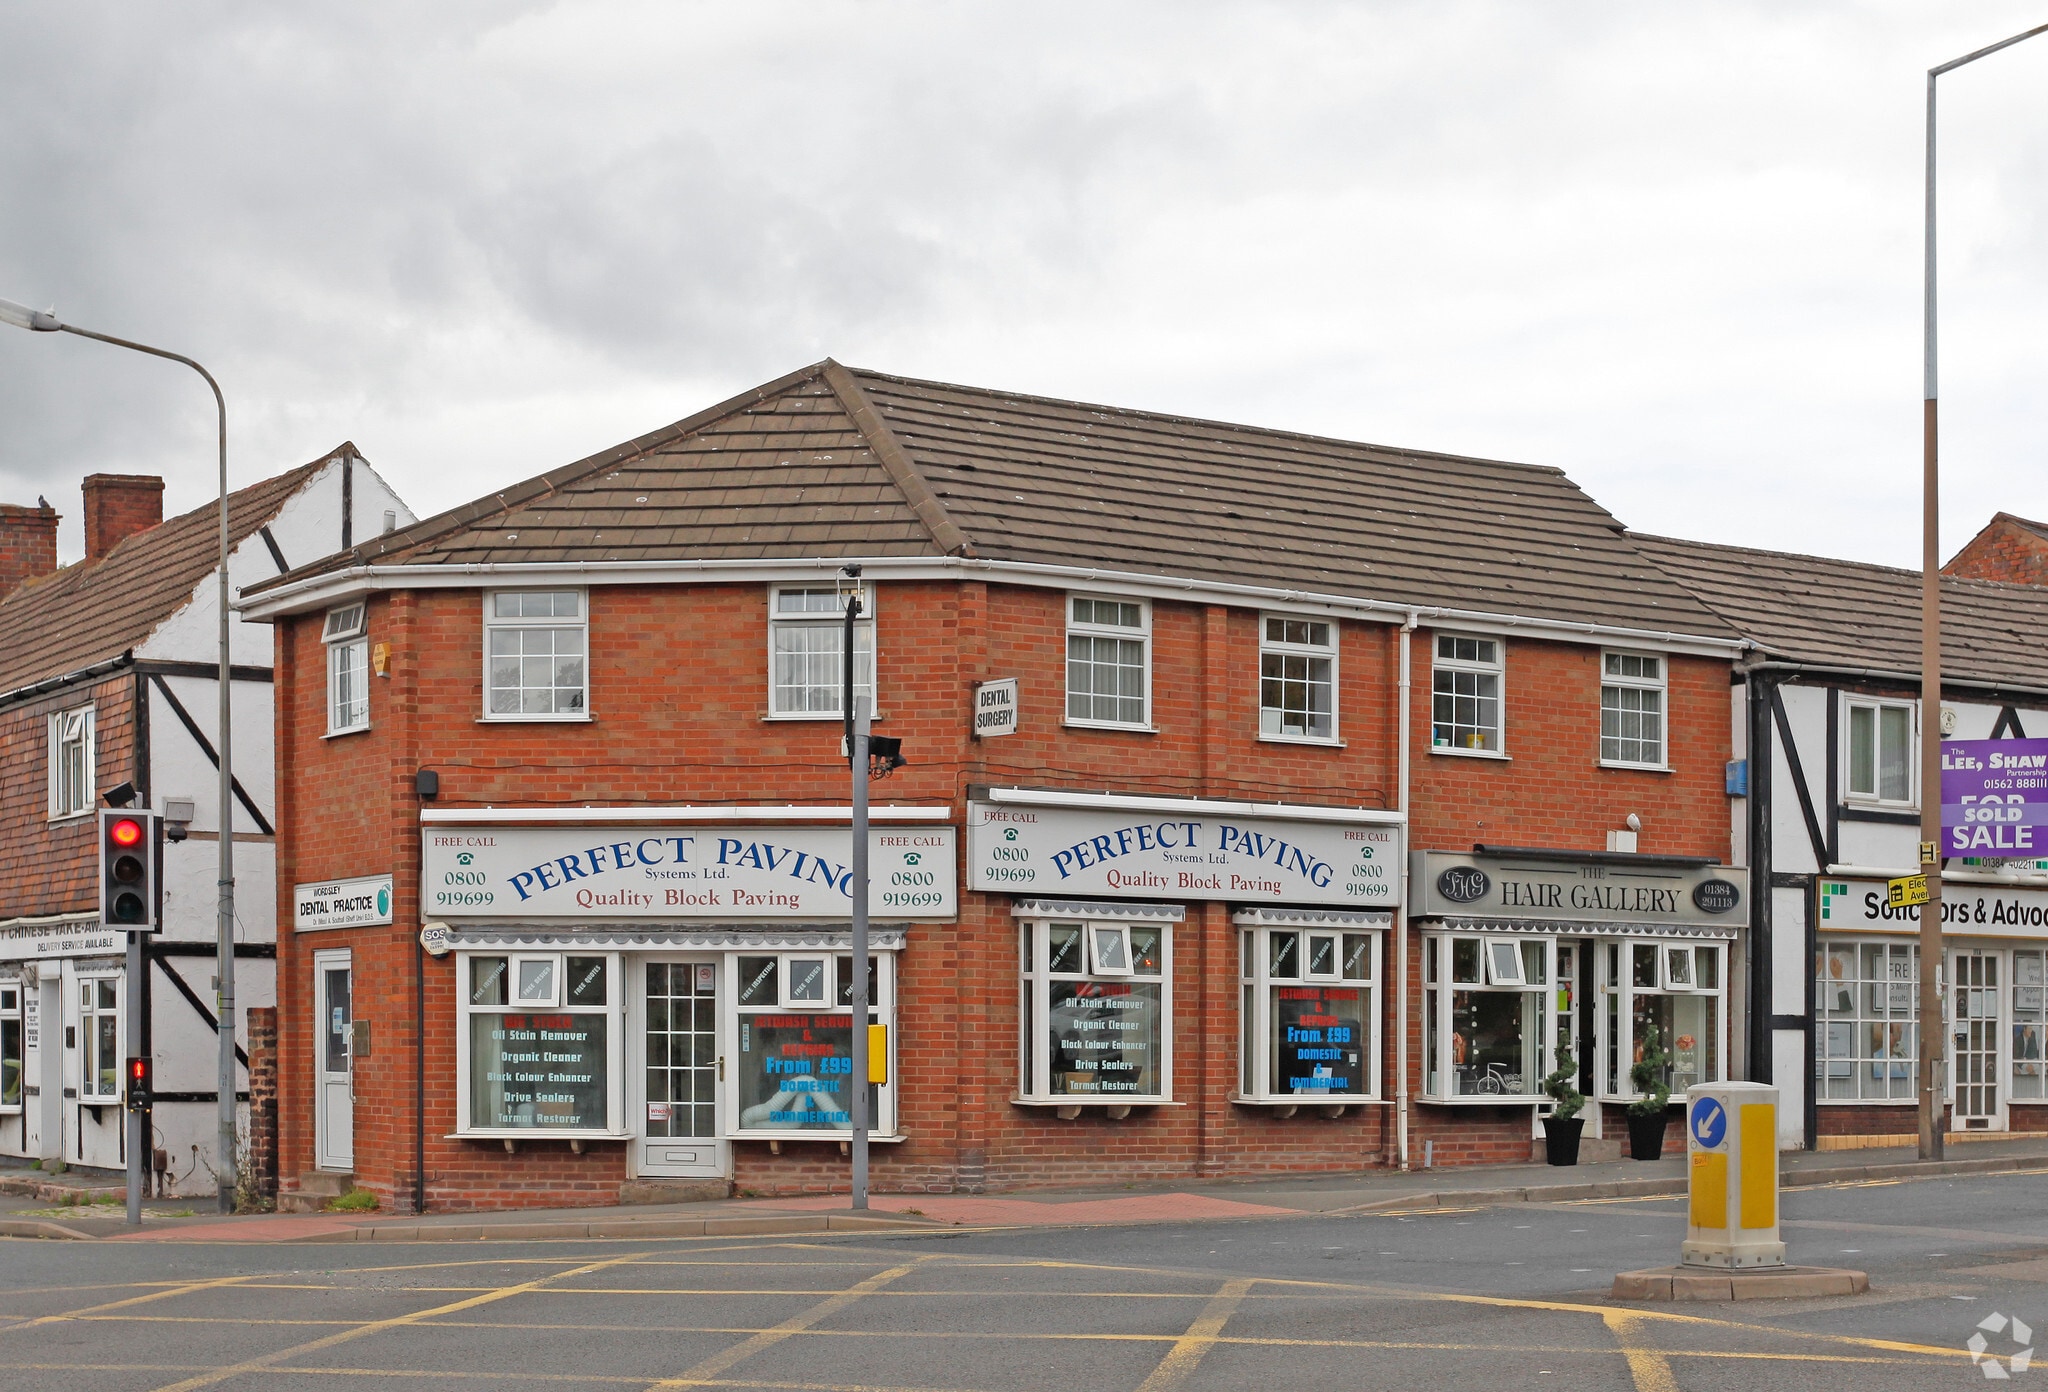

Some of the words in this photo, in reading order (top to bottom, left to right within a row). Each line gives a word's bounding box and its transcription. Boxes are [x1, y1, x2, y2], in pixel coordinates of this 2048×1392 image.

[981, 689, 1010, 707] DENTAL
[977, 709, 1013, 728] SURGERY
[1951, 748, 1964, 757] The
[1989, 752, 2047, 770] SHAW
[2007, 769, 2047, 779] Partnership
[1984, 779, 2012, 789] 01562
[2016, 778, 2047, 789] 888111
[984, 811, 1008, 822] FREE
[1012, 813, 1038, 823] CALL
[1965, 808, 2023, 822] SOLD
[434, 837, 463, 847] FREE
[467, 837, 497, 847] CALL
[880, 837, 909, 847] FREE
[914, 837, 945, 847] CALL
[1344, 831, 1365, 841] FREE
[1368, 832, 1390, 842] CALL
[1953, 825, 2033, 849] SALE
[993, 847, 1029, 862] 0800
[1050, 823, 1202, 880] PERFECT
[1218, 825, 1334, 888] PAVING
[1163, 851, 1203, 865] Systems
[1209, 853, 1229, 865] Ltd.
[507, 837, 695, 902] PERFECT
[646, 868, 697, 881] Systems
[704, 867, 730, 879] Ltd.
[986, 867, 1035, 883] 919699
[1352, 864, 1383, 878] 0800
[1580, 867, 1605, 879] THE
[444, 872, 486, 886] 0800
[891, 872, 934, 886] 0800
[1107, 869, 1169, 890] Quality
[1178, 872, 1221, 889] Block
[1230, 874, 1281, 895] Paving
[314, 886, 340, 897] WORDSLEY
[1346, 882, 1388, 897] 919699
[1704, 884, 1730, 896] 01384
[437, 891, 494, 906] 919699
[576, 889, 653, 909] Quality
[665, 888, 720, 905] Block
[732, 889, 800, 909] Paving
[883, 892, 943, 906] 919699
[1501, 881, 1563, 906] HAIR
[1570, 885, 1682, 913] GALLERY
[1701, 896, 1732, 908] 291113
[301, 901, 329, 916] DENTAL
[334, 896, 372, 912] PRACTICE
[1974, 898, 1986, 924] &
[9, 925, 50, 939] CHINESE
[426, 929, 445, 940] SOS
[38, 942, 60, 952] DELIVERY
[62, 940, 83, 950] SERVICE
[85, 938, 113, 949] AVAILABLE
[1060, 930, 1079, 960] INSPECTION
[1278, 936, 1295, 963] INSPECTION
[483, 962, 507, 988] INSPECTION
[534, 966, 552, 985] DESIGN
[585, 964, 602, 983] QUOTES
[752, 961, 775, 988] INSPECTION
[804, 965, 822, 984] DESIGN
[1066, 998, 1077, 1008] Oil
[1081, 998, 1102, 1009] Stain
[1106, 999, 1144, 1009] Remover
[1315, 1001, 1323, 1013] &
[1073, 1019, 1105, 1031] Organic
[1109, 1020, 1139, 1031] Cleaner
[492, 1030, 505, 1040] Oil
[510, 1030, 536, 1041] Stain
[541, 1030, 588, 1041] Remover
[803, 1029, 813, 1041] &
[1287, 1026, 1321, 1042] From
[1326, 1027, 1351, 1042] £99
[1085, 1040, 1109, 1050] Colour
[1112, 1041, 1147, 1050] Enhancer
[502, 1052, 540, 1064] Organic
[544, 1052, 582, 1062] Cleaner
[1297, 1048, 1342, 1060] DOMESTIC
[765, 1057, 811, 1074] From
[819, 1057, 852, 1074] £99
[1075, 1060, 1098, 1070] Drive
[1102, 1060, 1133, 1071] Sealers
[1315, 1063, 1323, 1075] &
[515, 1072, 544, 1082] Colour
[549, 1073, 592, 1082] Enhancer
[1290, 1077, 1348, 1089] COMMERCIAL
[780, 1080, 840, 1092] DOMESTIC
[1070, 1080, 1099, 1091] Tarmac
[1102, 1081, 1138, 1091] Restorer
[504, 1092, 532, 1102] Drive
[536, 1093, 575, 1103] Sealers
[805, 1095, 815, 1108] &
[498, 1113, 532, 1123] Tarmac
[537, 1114, 581, 1123] Restorer
[770, 1111, 850, 1123] COMMERCIAL
